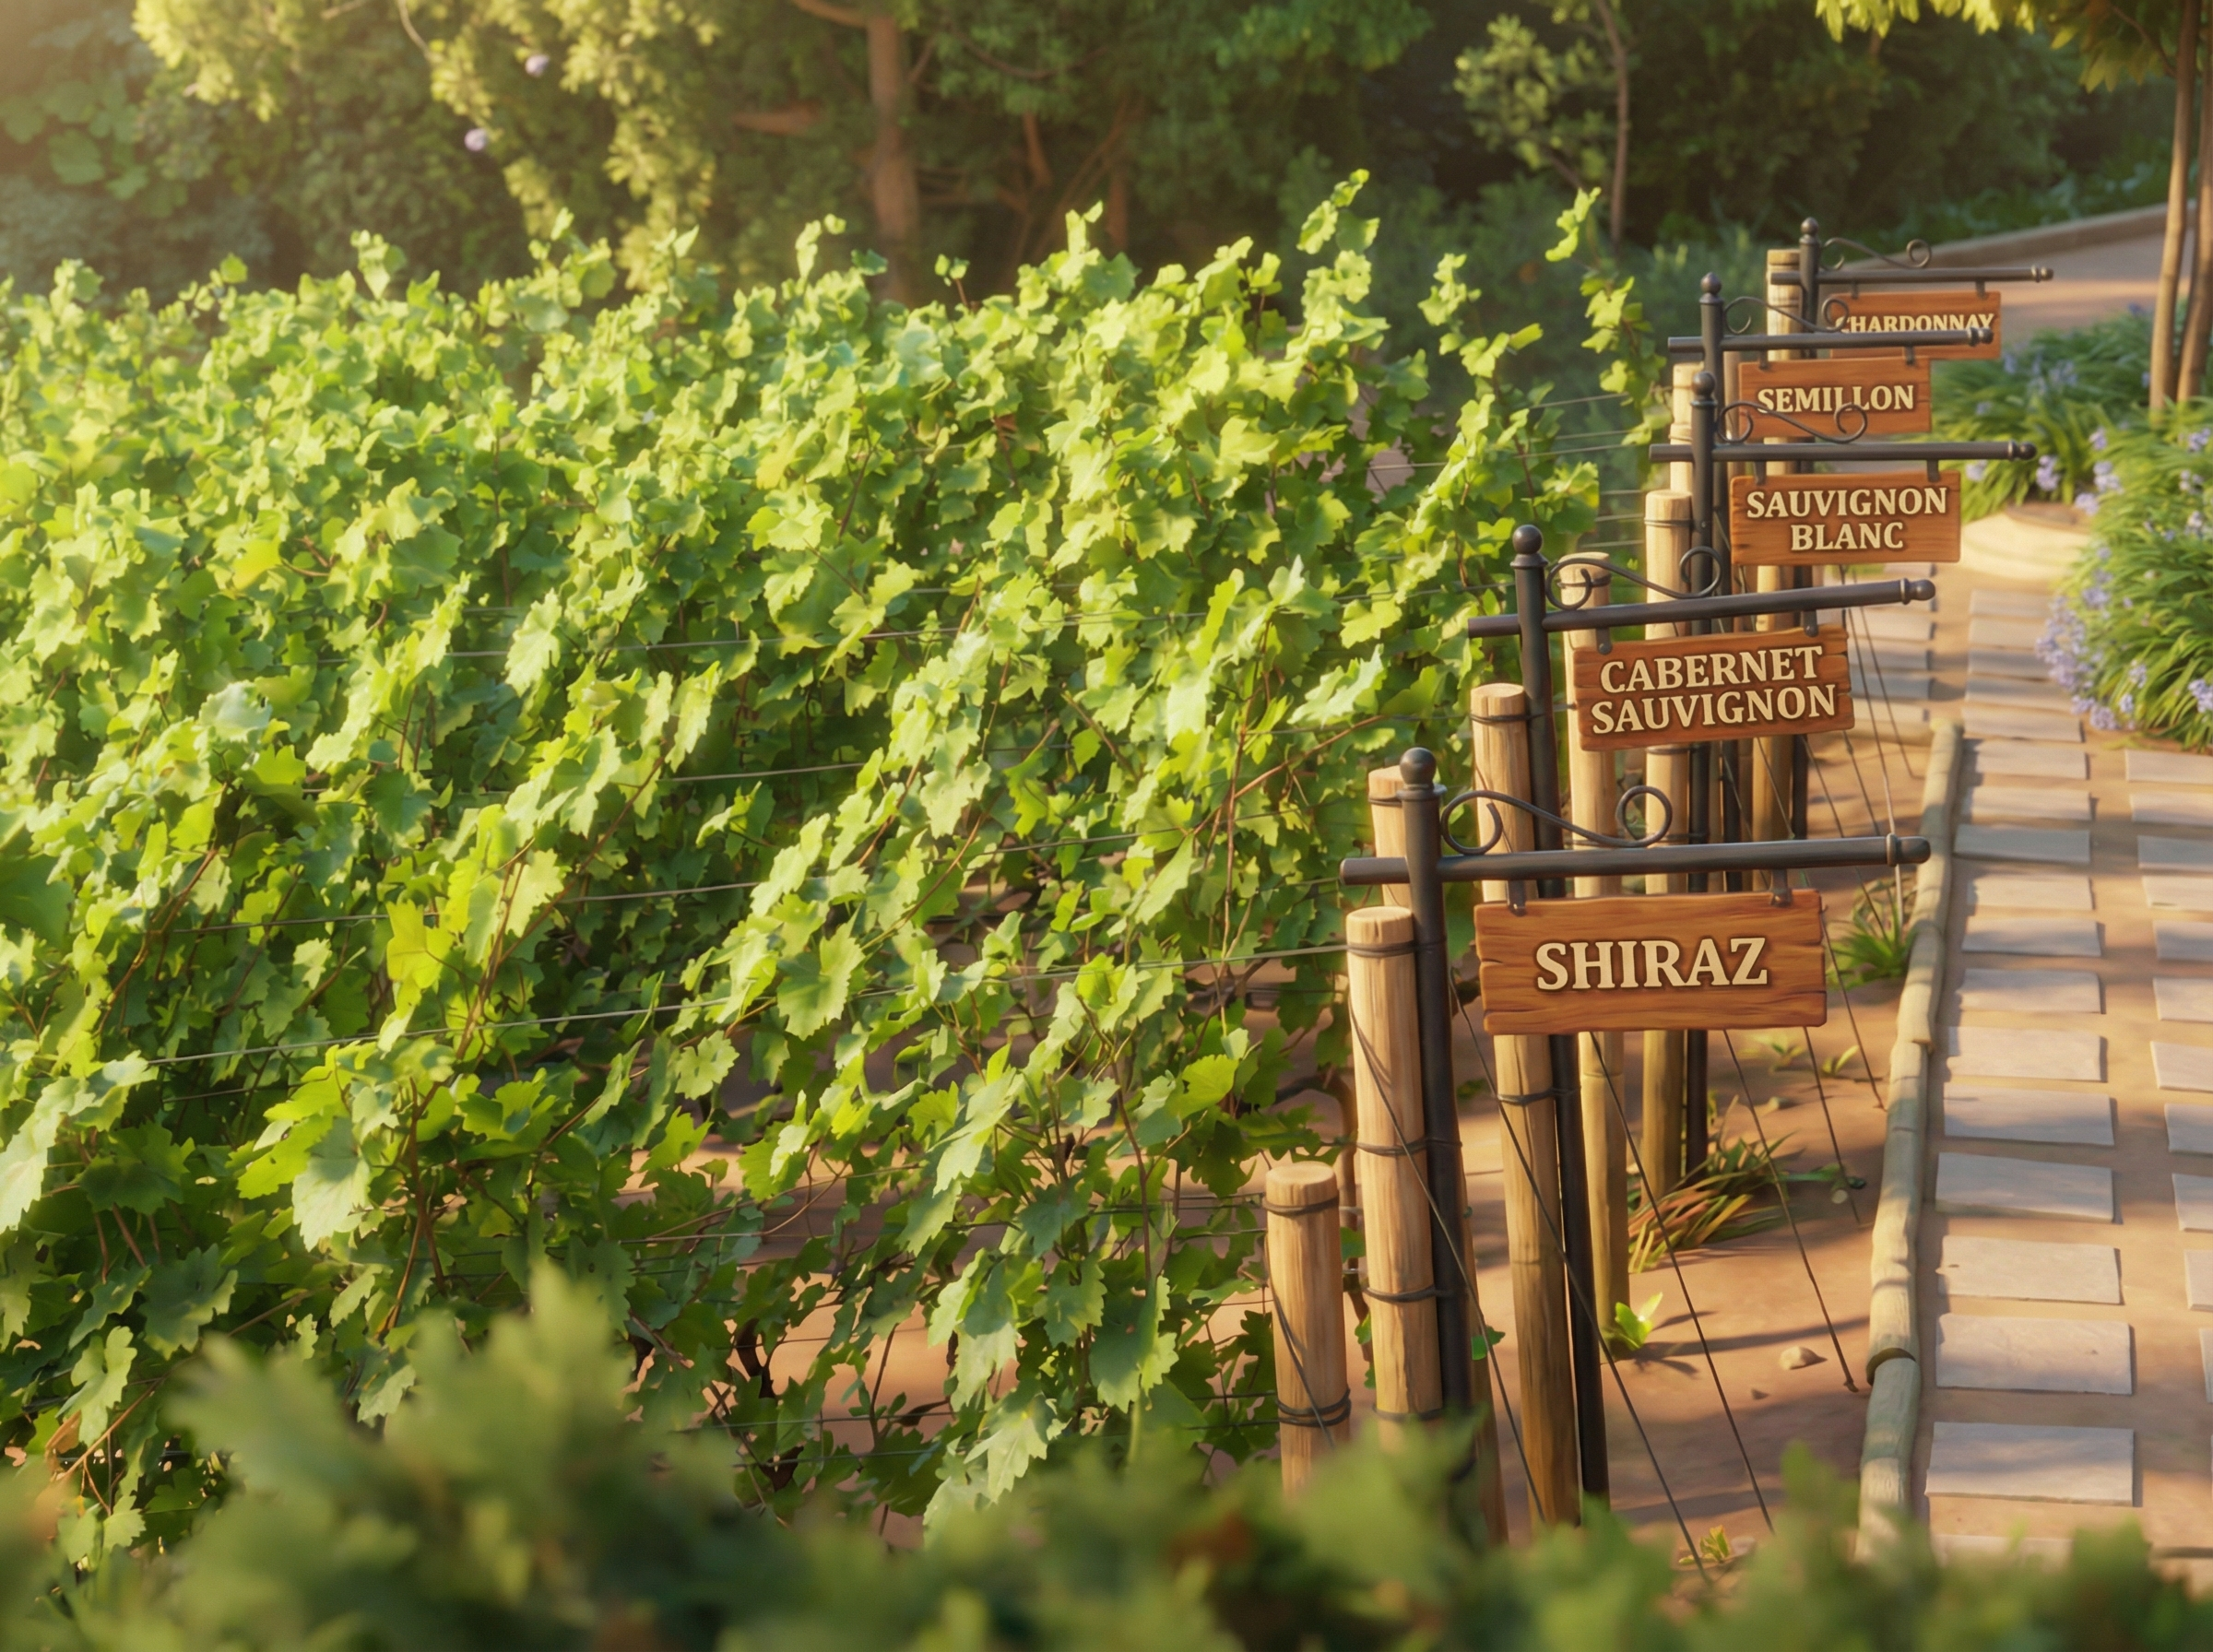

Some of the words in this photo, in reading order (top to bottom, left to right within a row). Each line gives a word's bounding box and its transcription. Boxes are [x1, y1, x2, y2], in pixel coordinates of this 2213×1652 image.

[1757, 384, 1914, 414] SEMILLON
[1746, 487, 1947, 518] SAUVIGNON
[1791, 522, 1904, 550] BLANC
[1600, 645, 1823, 693] CABERNET
[1591, 684, 1836, 734] SAUVIGNON
[1535, 937, 1768, 991] SHIRAZ
